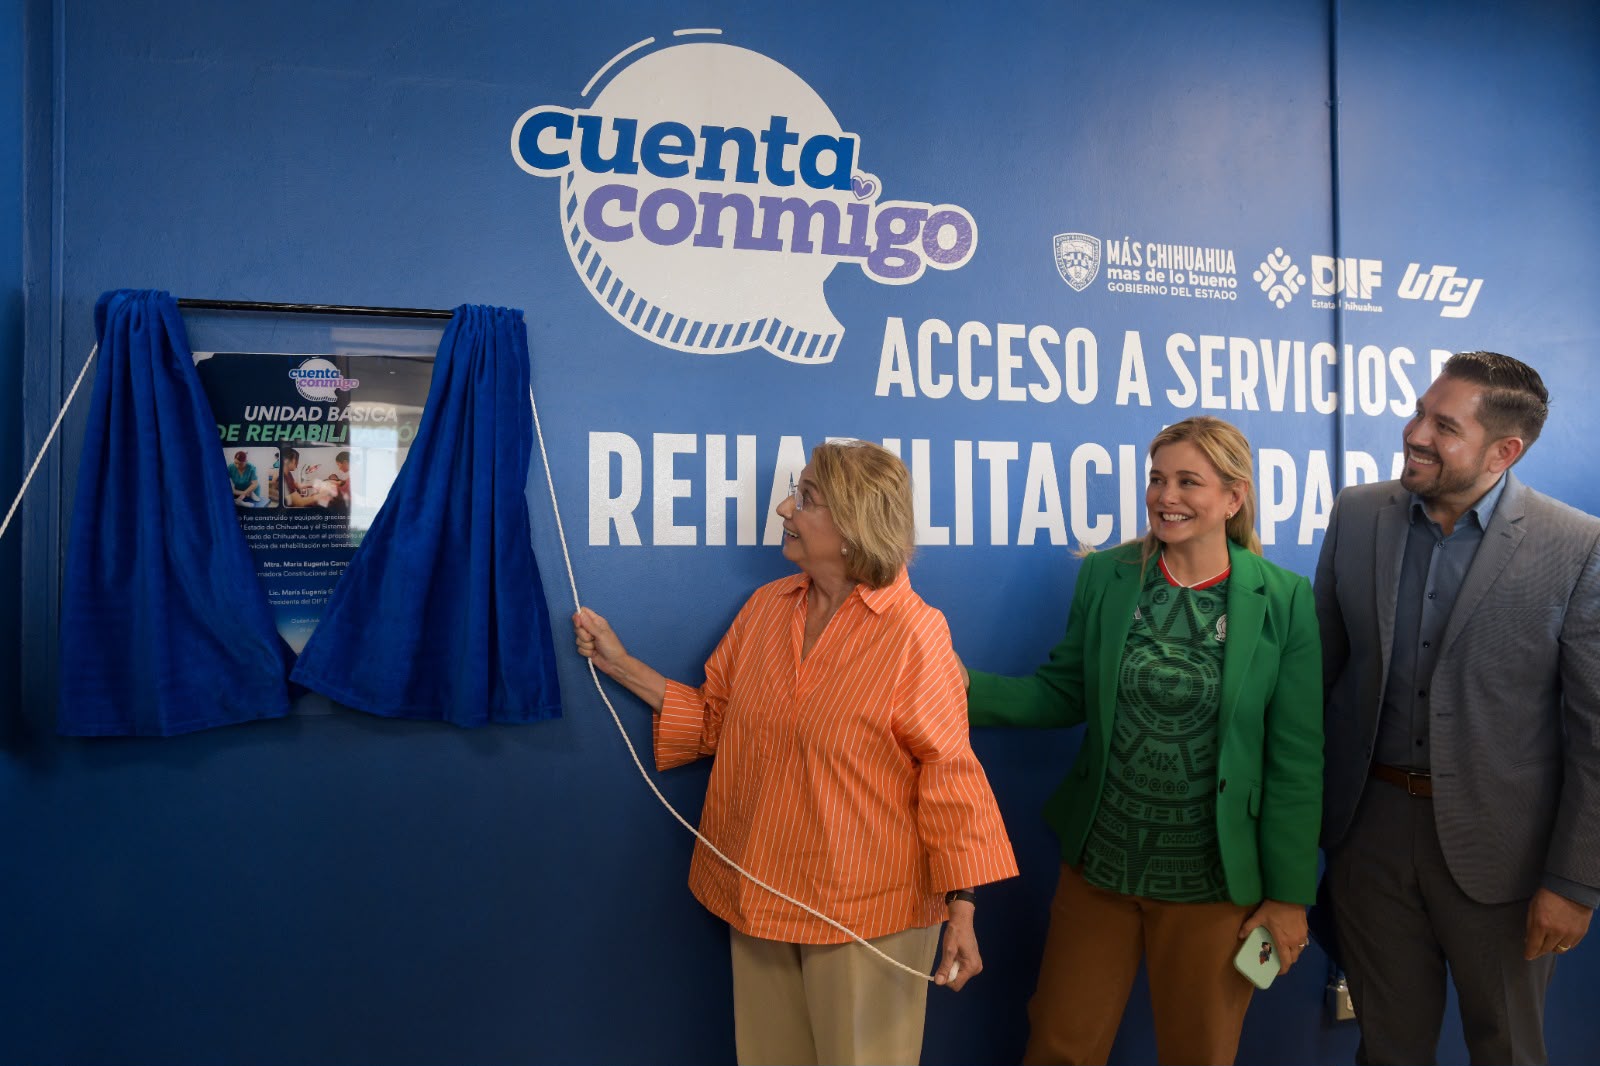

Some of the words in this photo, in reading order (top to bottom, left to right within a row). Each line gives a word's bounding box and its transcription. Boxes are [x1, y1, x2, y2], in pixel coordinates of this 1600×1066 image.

[518, 111, 856, 191] cuenta
[583, 178, 973, 279] conmigo
[1106, 236, 1142, 267] MÁS
[1146, 242, 1237, 275] CHIHUAHUA
[1107, 266, 1141, 282] mas
[1145, 268, 1166, 283] de
[1170, 269, 1185, 284] lo
[1188, 270, 1238, 288] bueno
[1311, 254, 1383, 300] DIF
[1107, 281, 1168, 295] GOBIERNO
[1171, 286, 1193, 297] DEL
[1195, 287, 1238, 301] ESTADO
[1344, 301, 1383, 313] hihuahua
[289, 368, 340, 379] cuenta
[874, 316, 1099, 405] ACCESO
[1115, 330, 1152, 407] A
[1165, 332, 1417, 418] SERVICIOS
[298, 377, 359, 391] conmigo
[244, 405, 322, 422] UNIDAD
[327, 403, 398, 423] BÁSICA
[245, 421, 418, 443] REHABILIÓ
[588, 425, 1154, 546] REHALITACI
[1258, 448, 1404, 546] PA
[330, 560, 350, 568] Camp
